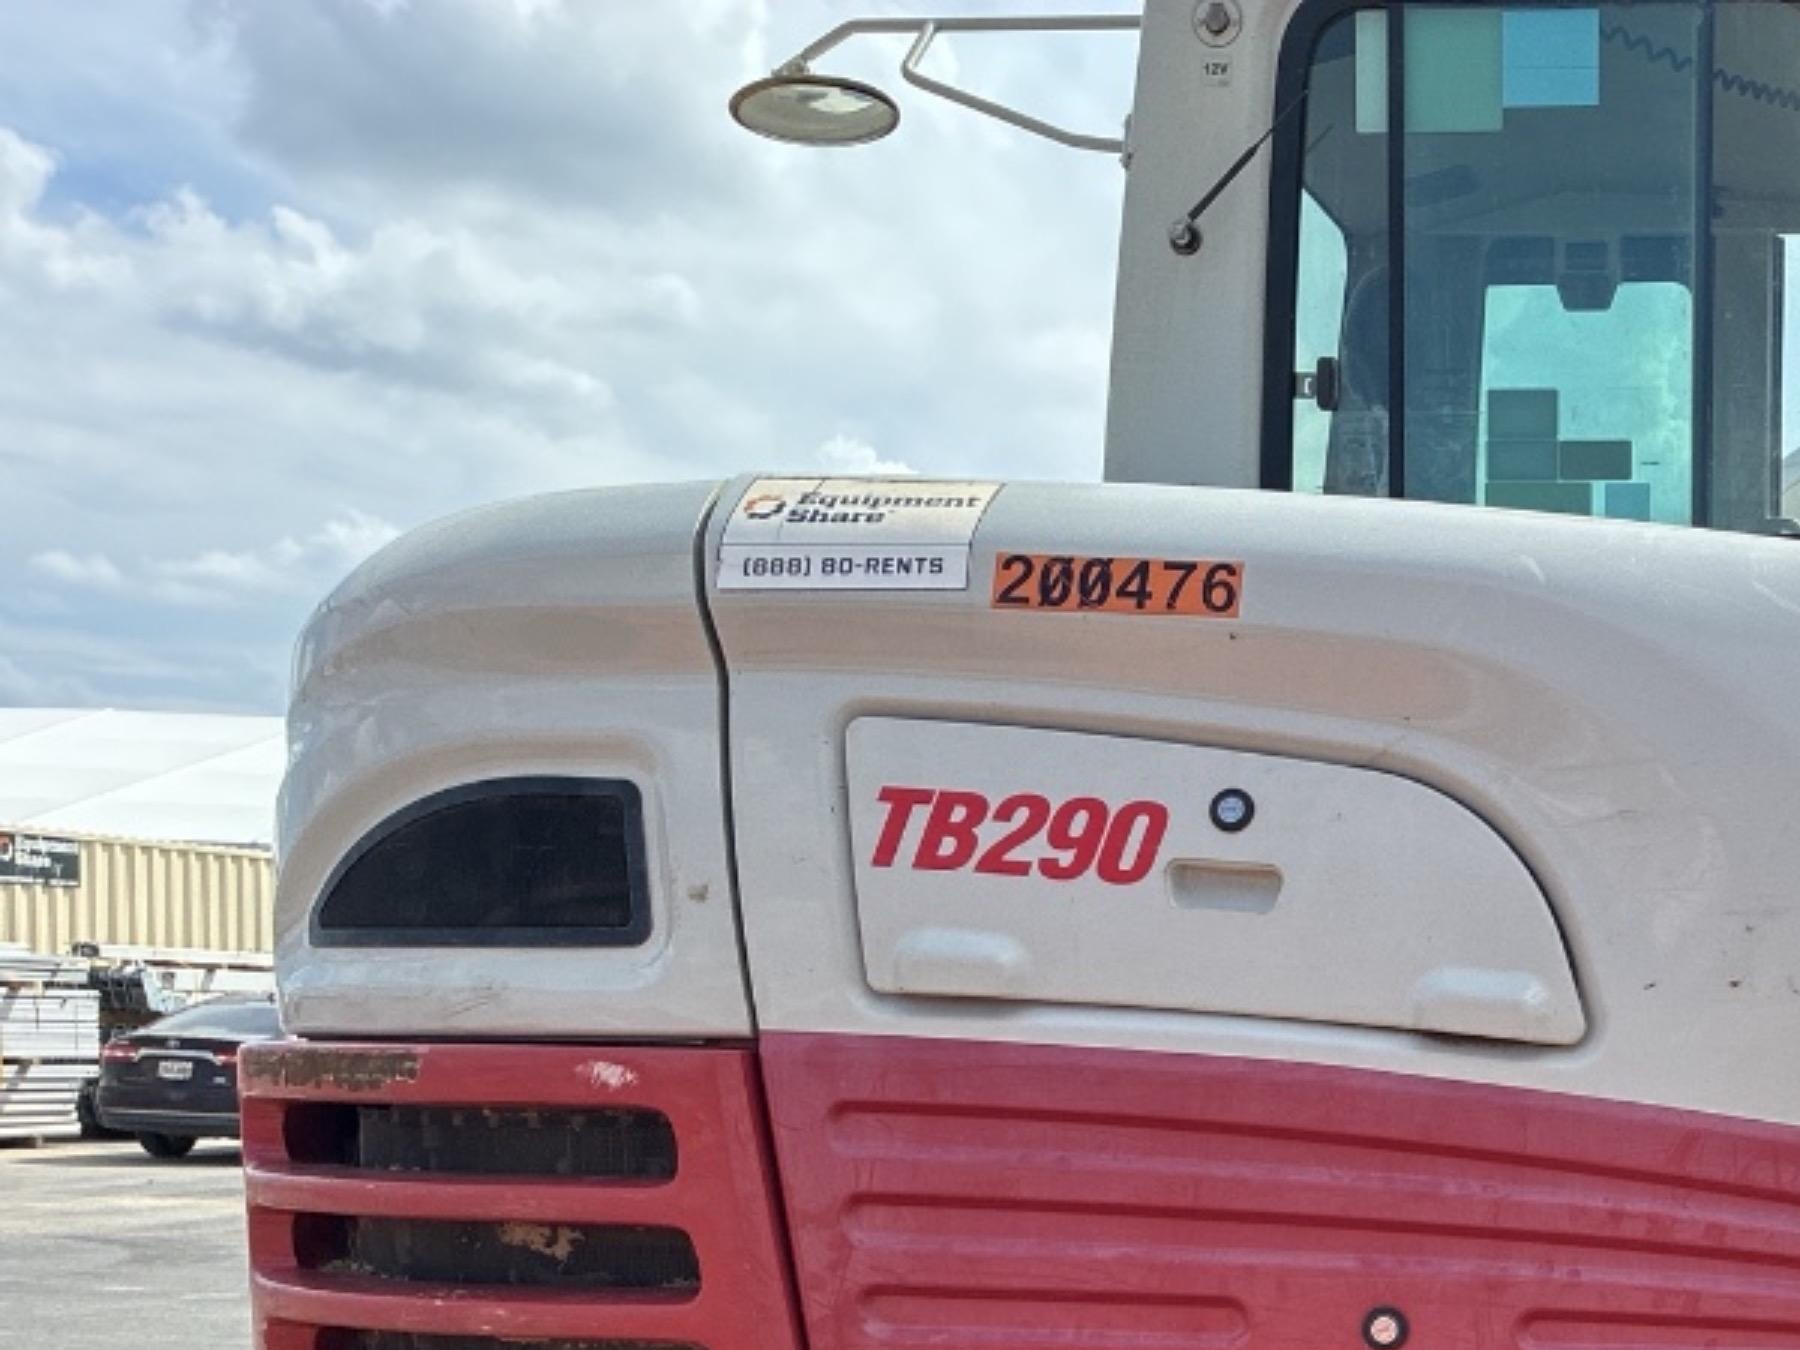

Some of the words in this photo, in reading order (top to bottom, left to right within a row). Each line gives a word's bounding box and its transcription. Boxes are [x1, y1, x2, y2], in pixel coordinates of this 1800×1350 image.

[797, 492, 981, 509] Equipment
[786, 509, 886, 524] Share
[743, 557, 811, 578] (888)
[1000, 555, 1238, 613] 200476
[871, 785, 1170, 886] TB290
